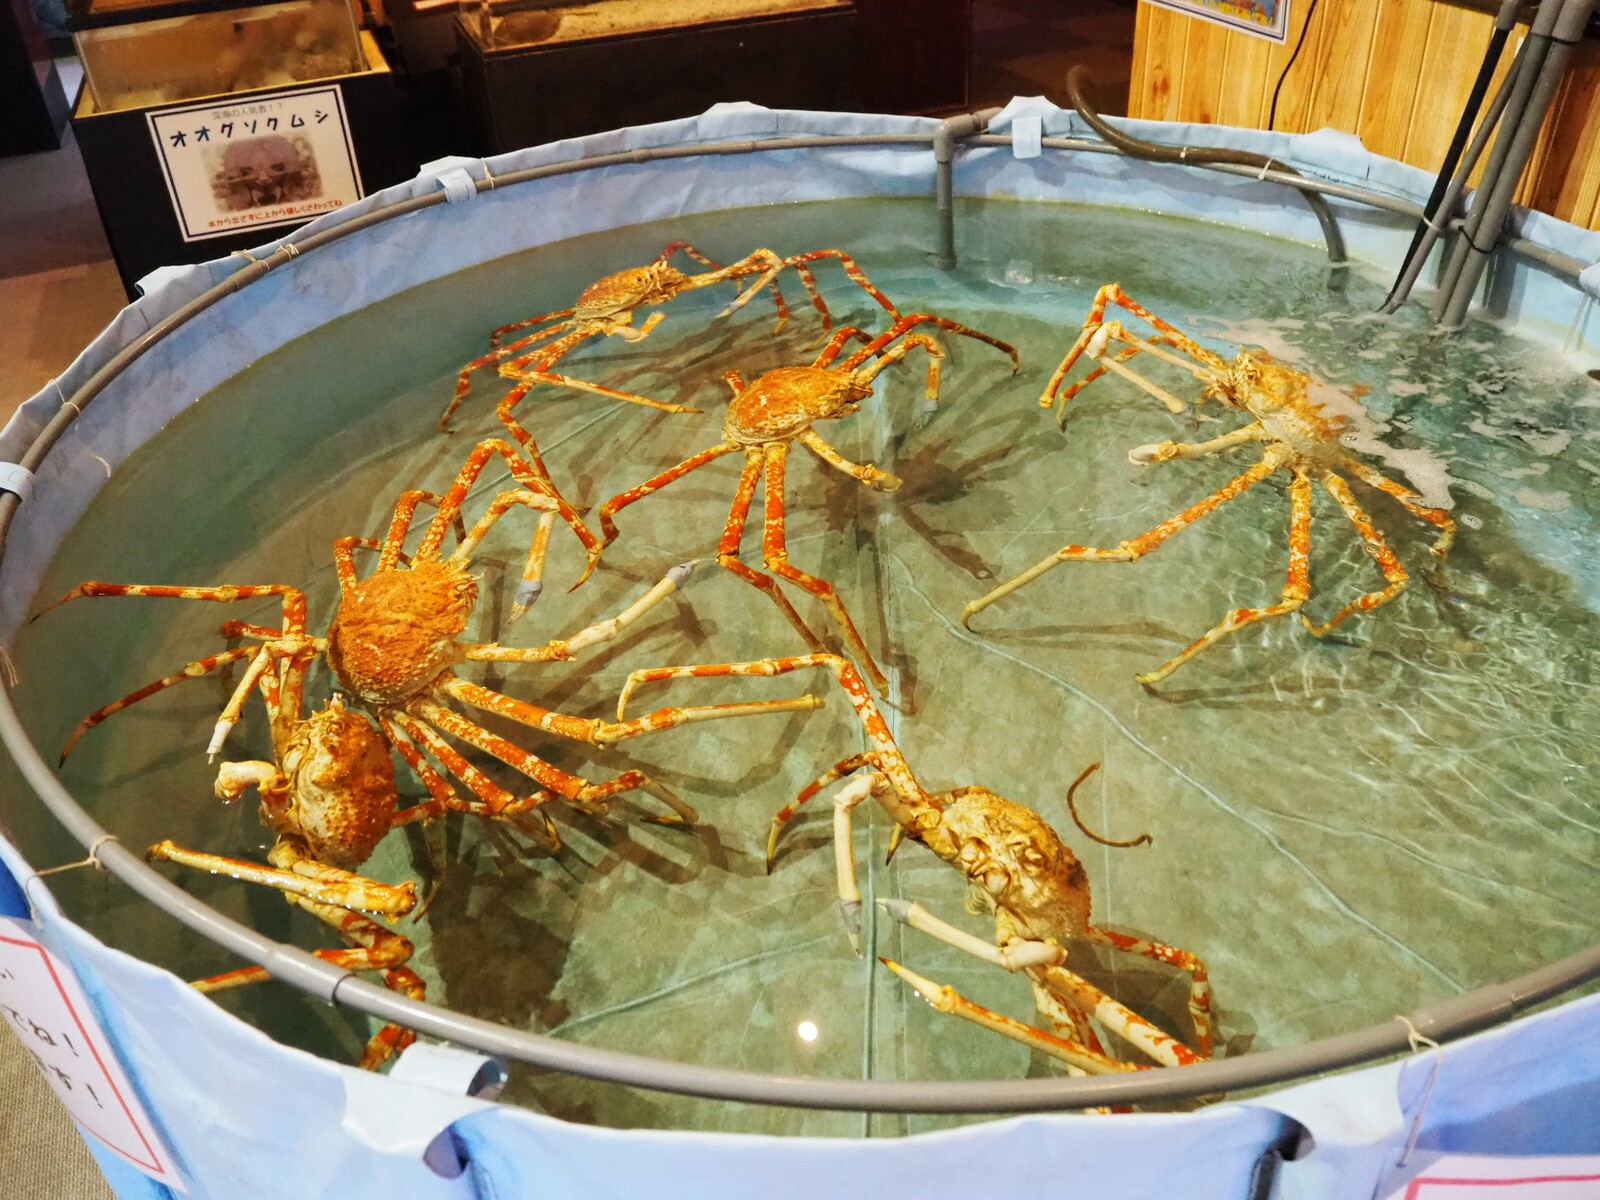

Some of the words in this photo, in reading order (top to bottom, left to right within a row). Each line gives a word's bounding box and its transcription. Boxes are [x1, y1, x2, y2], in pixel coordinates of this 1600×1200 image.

[170, 109, 328, 148] オオグソクムシ
